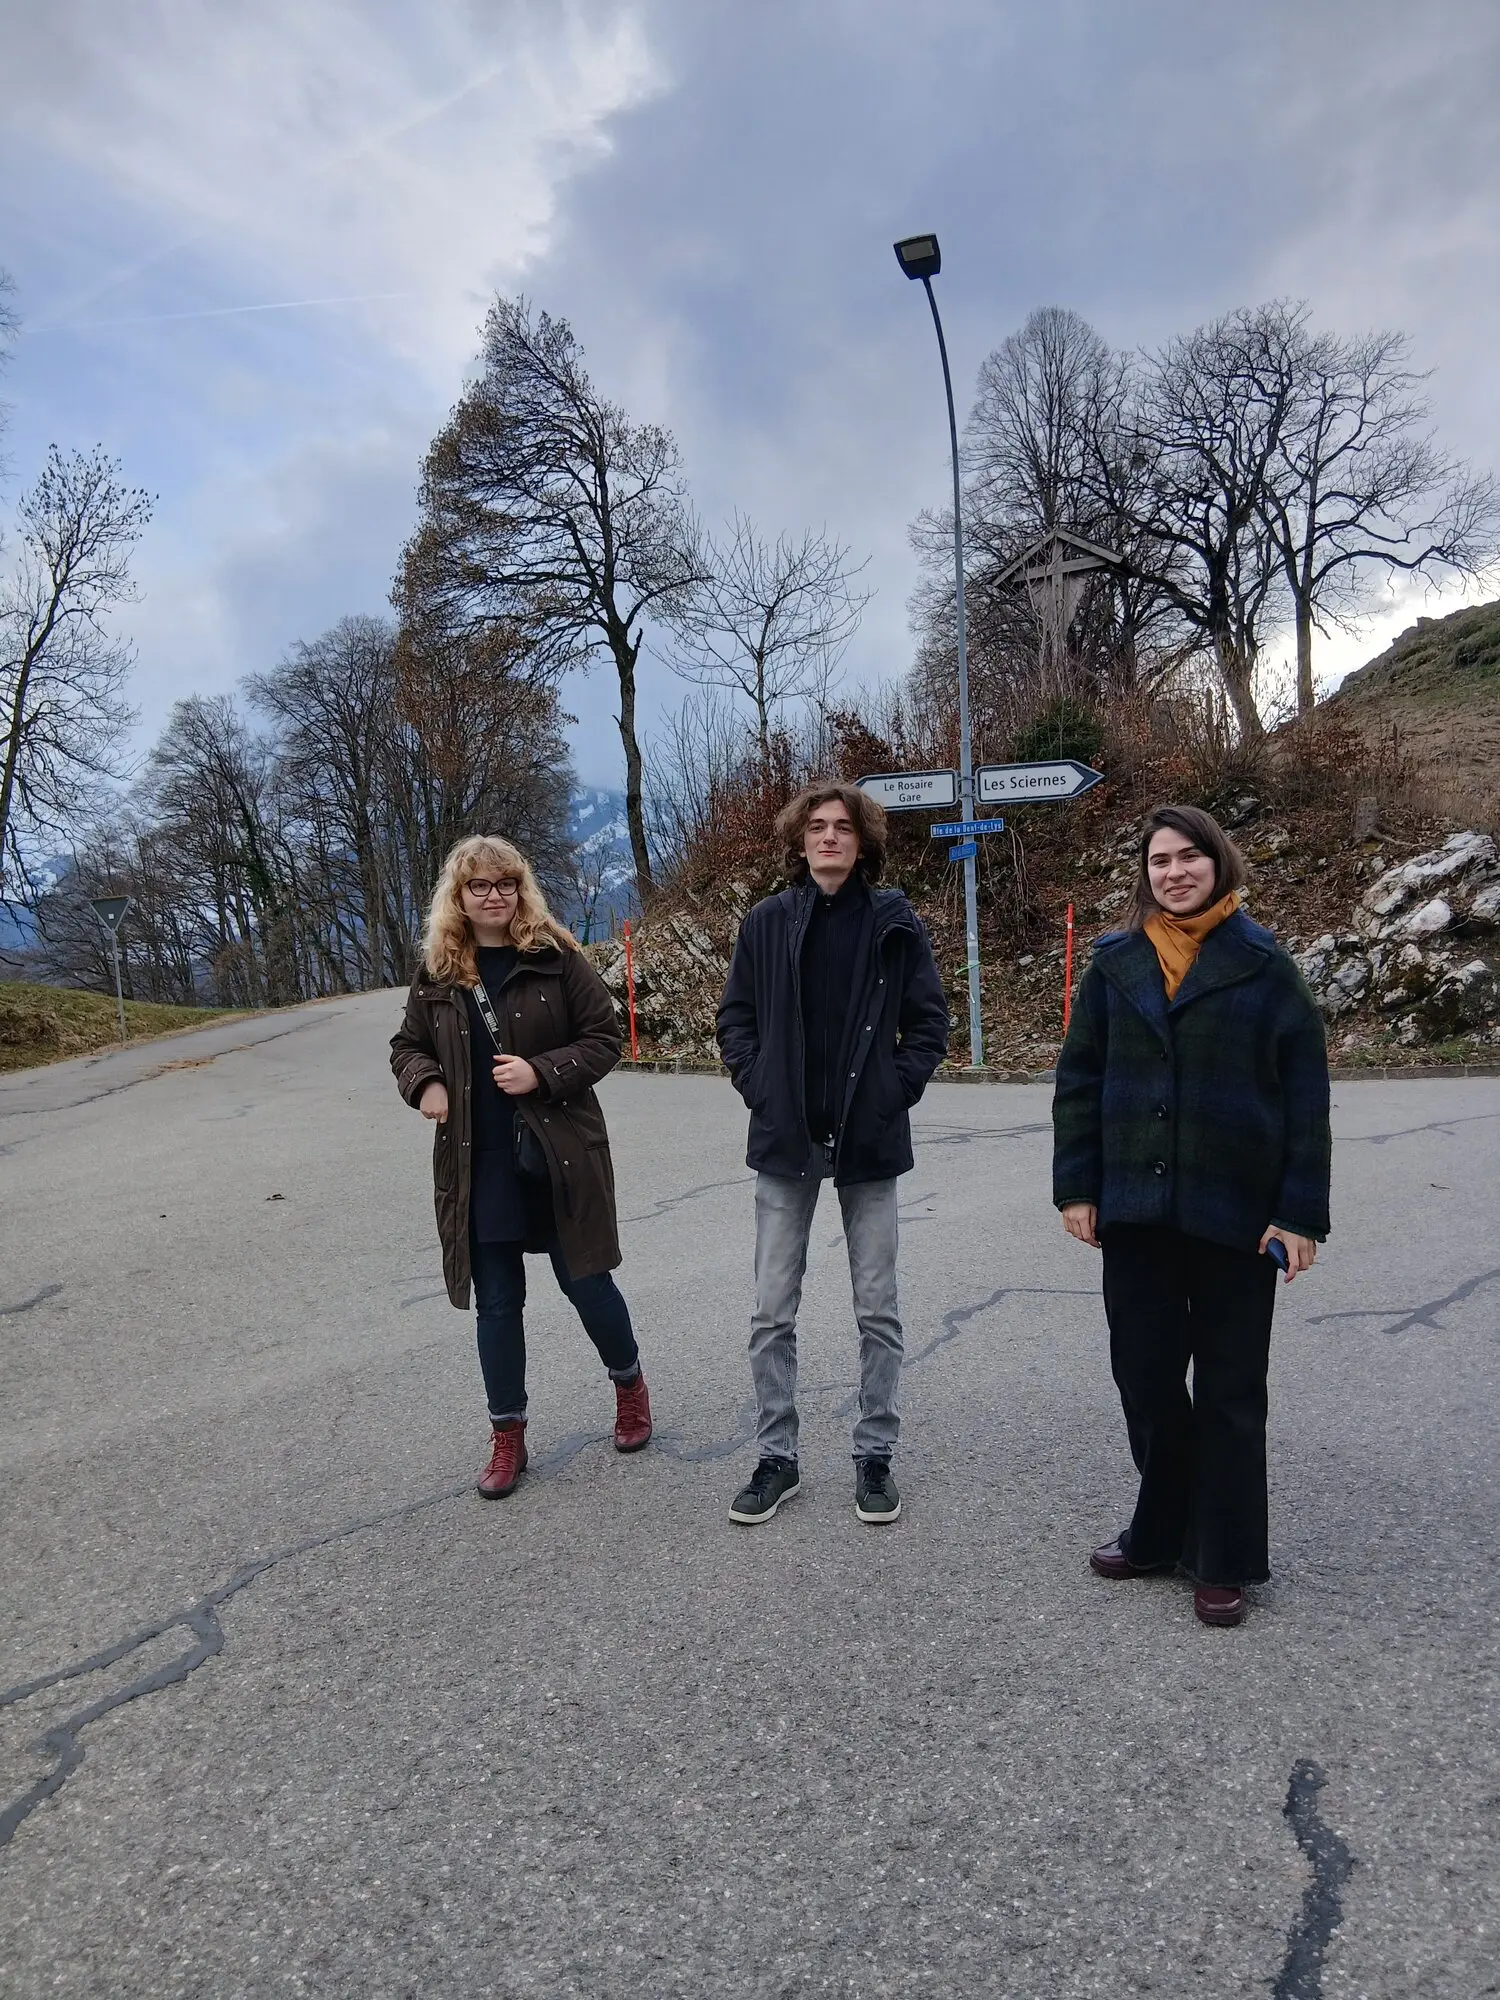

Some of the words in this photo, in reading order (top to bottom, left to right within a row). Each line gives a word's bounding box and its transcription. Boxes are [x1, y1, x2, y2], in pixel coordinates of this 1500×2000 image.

[884, 782, 895, 792] Le
[897, 779, 933, 791] Rosaire
[984, 778, 1005, 791] Les
[1010, 775, 1067, 789] Sciernes
[899, 793, 921, 802] Gare
[945, 825, 953, 834] de
[954, 825, 961, 833] la
[485, 1011, 500, 1033] PUMA
